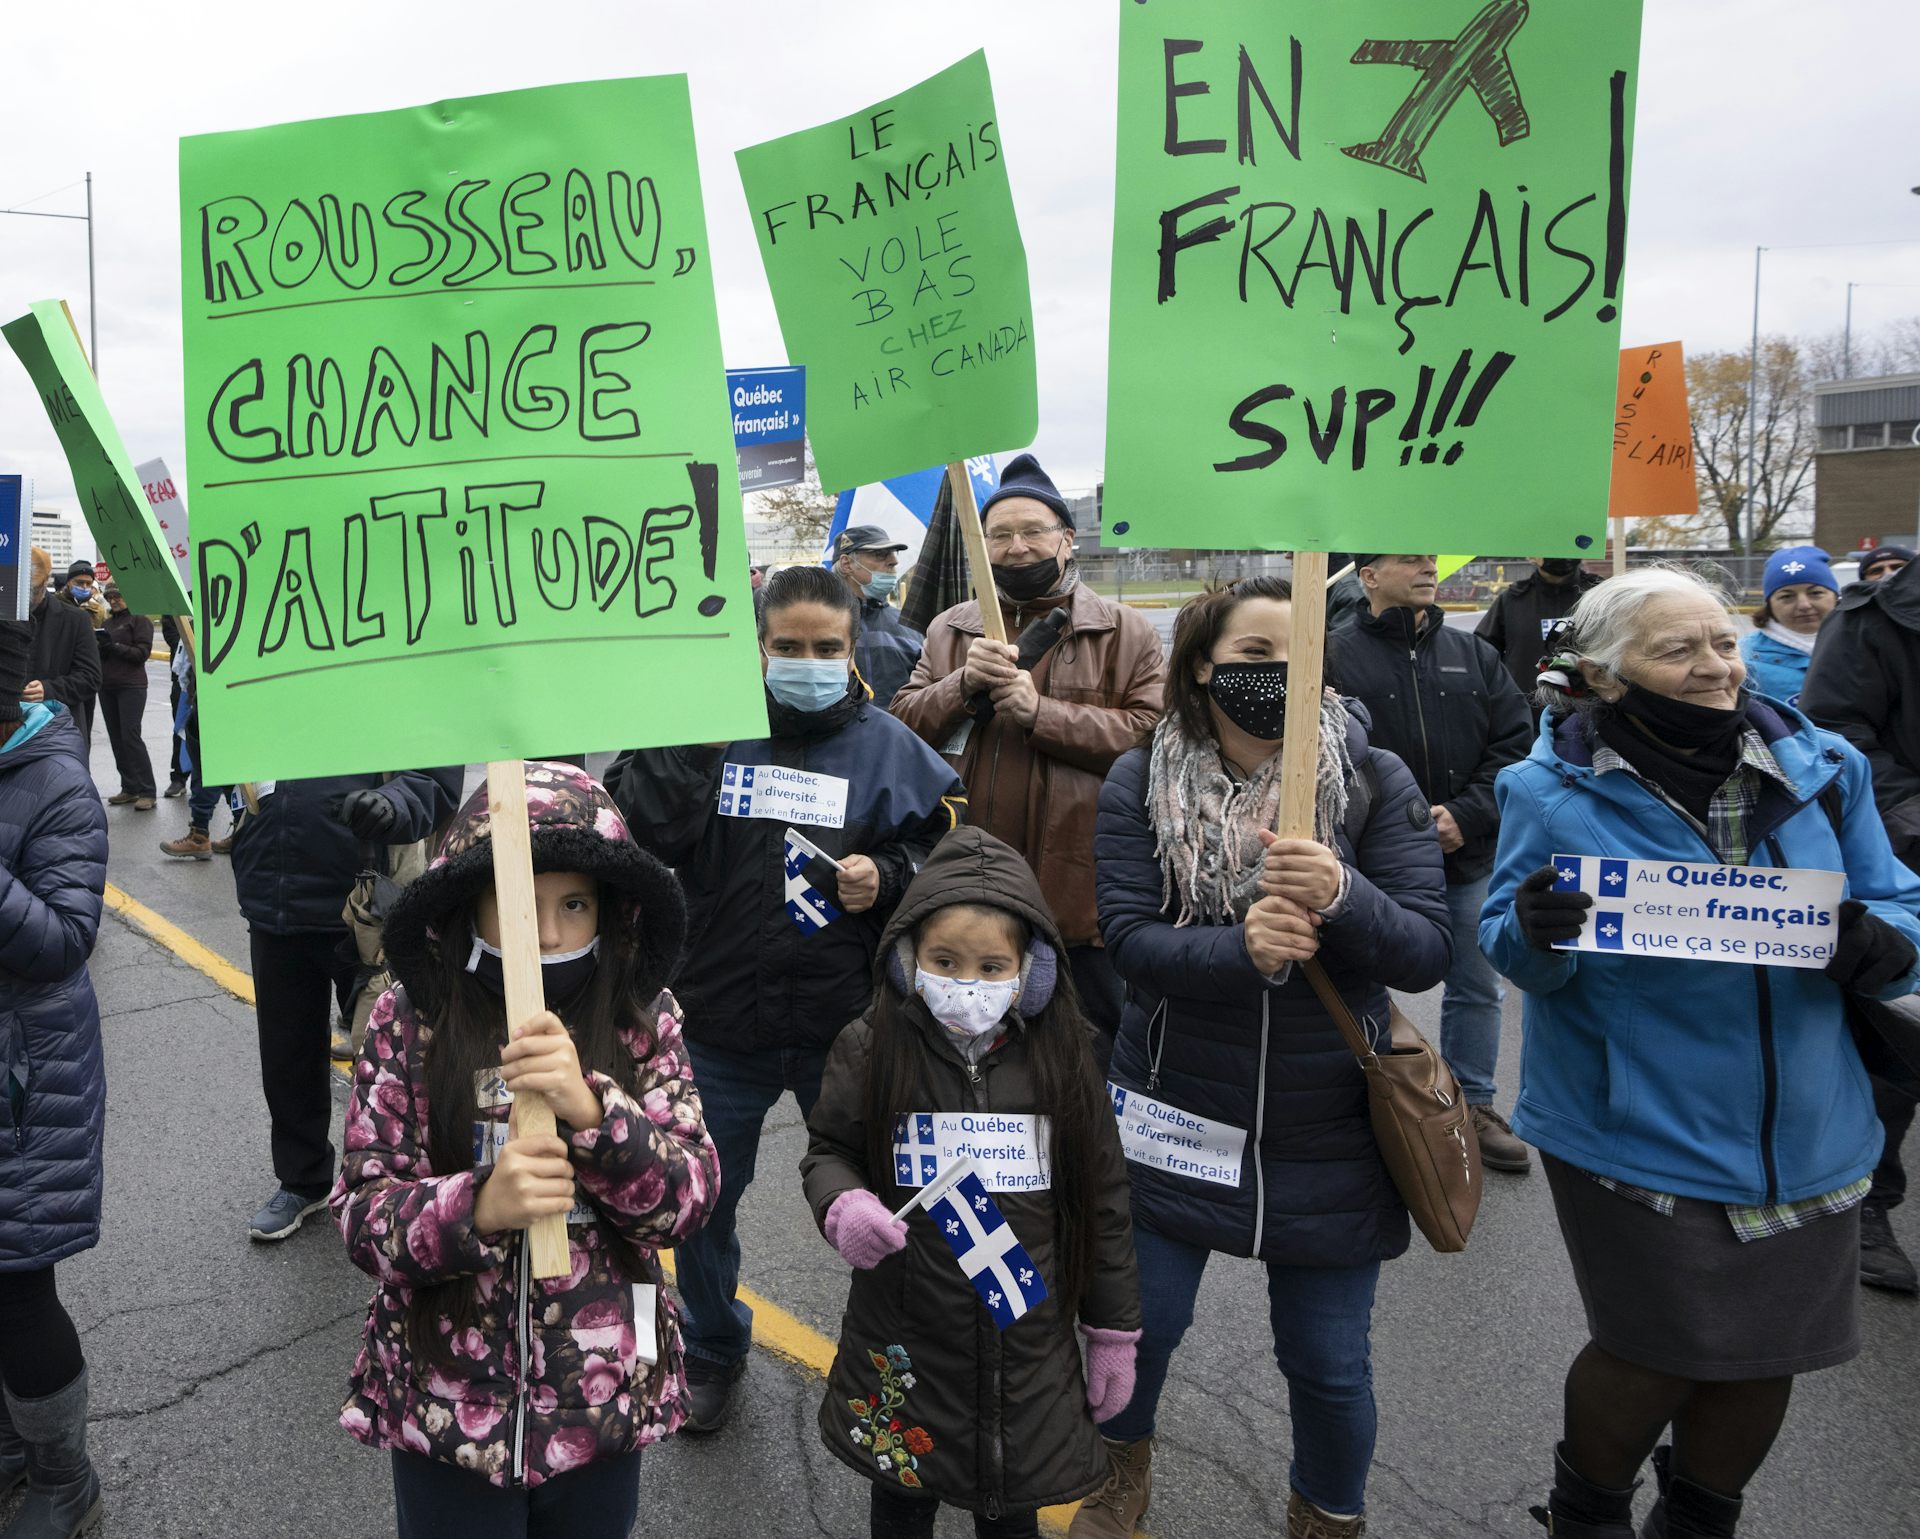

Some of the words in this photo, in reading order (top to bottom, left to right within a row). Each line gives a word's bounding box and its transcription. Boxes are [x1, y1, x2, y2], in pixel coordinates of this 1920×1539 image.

[1163, 34, 1302, 167] EN
[849, 109, 895, 161] LE
[199, 168, 697, 303] ROUSSEAU,
[839, 211, 965, 283] VOLE
[851, 255, 977, 327] BAS
[880, 309, 967, 356] CHEZ
[931, 317, 1028, 378] CANADA
[208, 322, 651, 464] CHANGE
[733, 384, 783, 407] Québec
[1212, 348, 1516, 473] SVP!!!
[758, 770, 769, 779] Au
[756, 789, 763, 797] la
[827, 800, 837, 808] ça
[764, 806, 775, 816] vit
[777, 810, 788, 818] en
[790, 808, 844, 826] français!
[1636, 869, 1660, 883] Au
[1666, 865, 1789, 892] Québec,
[1633, 901, 1673, 917] c'est
[1677, 906, 1700, 918] en
[1706, 898, 1832, 929] français
[1632, 932, 1678, 951] que
[1686, 936, 1712, 955] ça
[1720, 939, 1746, 954] se
[1755, 941, 1834, 961] passe!
[941, 1120, 957, 1131] Au
[961, 1117, 1027, 1135] Québec,
[1129, 1099, 1144, 1112] Au
[1146, 1103, 1208, 1135] Québec,
[486, 1133, 505, 1146] Au
[943, 1146, 953, 1158] la
[1125, 1121, 1134, 1131] la
[1216, 1148, 1229, 1160] ça
[995, 1170, 1050, 1189] français!
[1133, 1149, 1146, 1160] vit
[1149, 1154, 1163, 1165] en
[1166, 1154, 1238, 1182] français!
